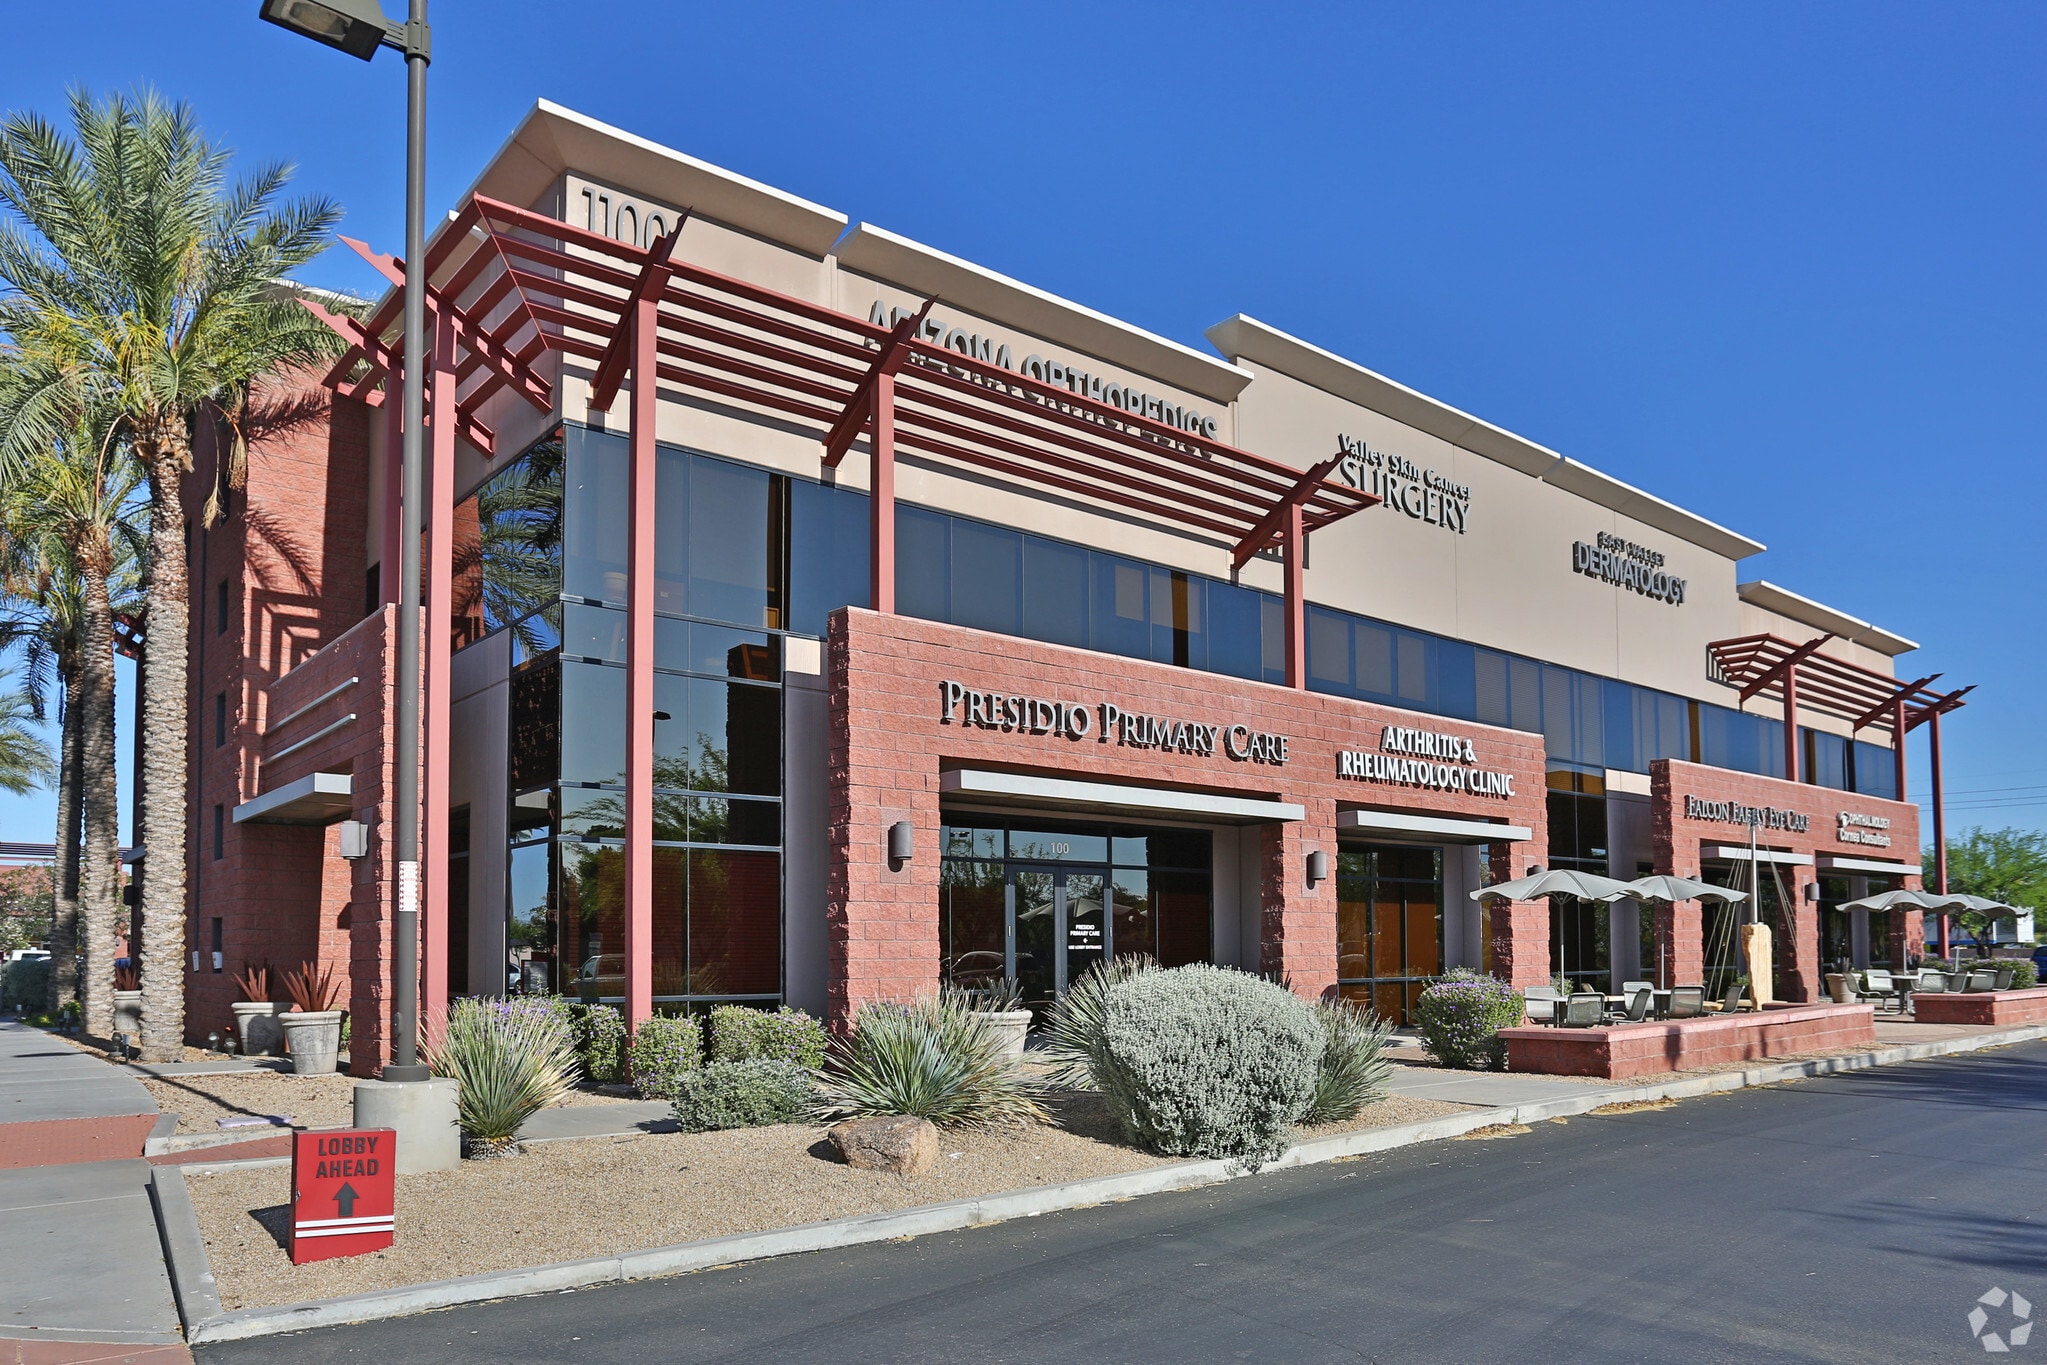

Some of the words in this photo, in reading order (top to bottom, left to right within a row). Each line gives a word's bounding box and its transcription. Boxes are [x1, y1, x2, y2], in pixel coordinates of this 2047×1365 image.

[582, 186, 669, 250] 1100
[1388, 455, 1420, 482] Skin
[1341, 459, 1471, 534] SURGERY
[1574, 540, 1687, 605] DERMATOLOGY
[940, 680, 1092, 740] PRESIDIO
[1099, 703, 1221, 755] PRIMARY
[1225, 723, 1290, 763] CARE
[1382, 726, 1462, 760] ARTHRITIS
[1461, 738, 1478, 763] &
[1338, 750, 1467, 790] RHEUMATOLOGY
[1469, 768, 1516, 797] CLINIC
[1685, 794, 1729, 821] FALCON
[1766, 806, 1786, 829] EYE
[1785, 809, 1811, 833] CARE
[1050, 842, 1069, 854] 100
[318, 1136, 379, 1156] LOBBY
[316, 1159, 379, 1178] AHEAD
